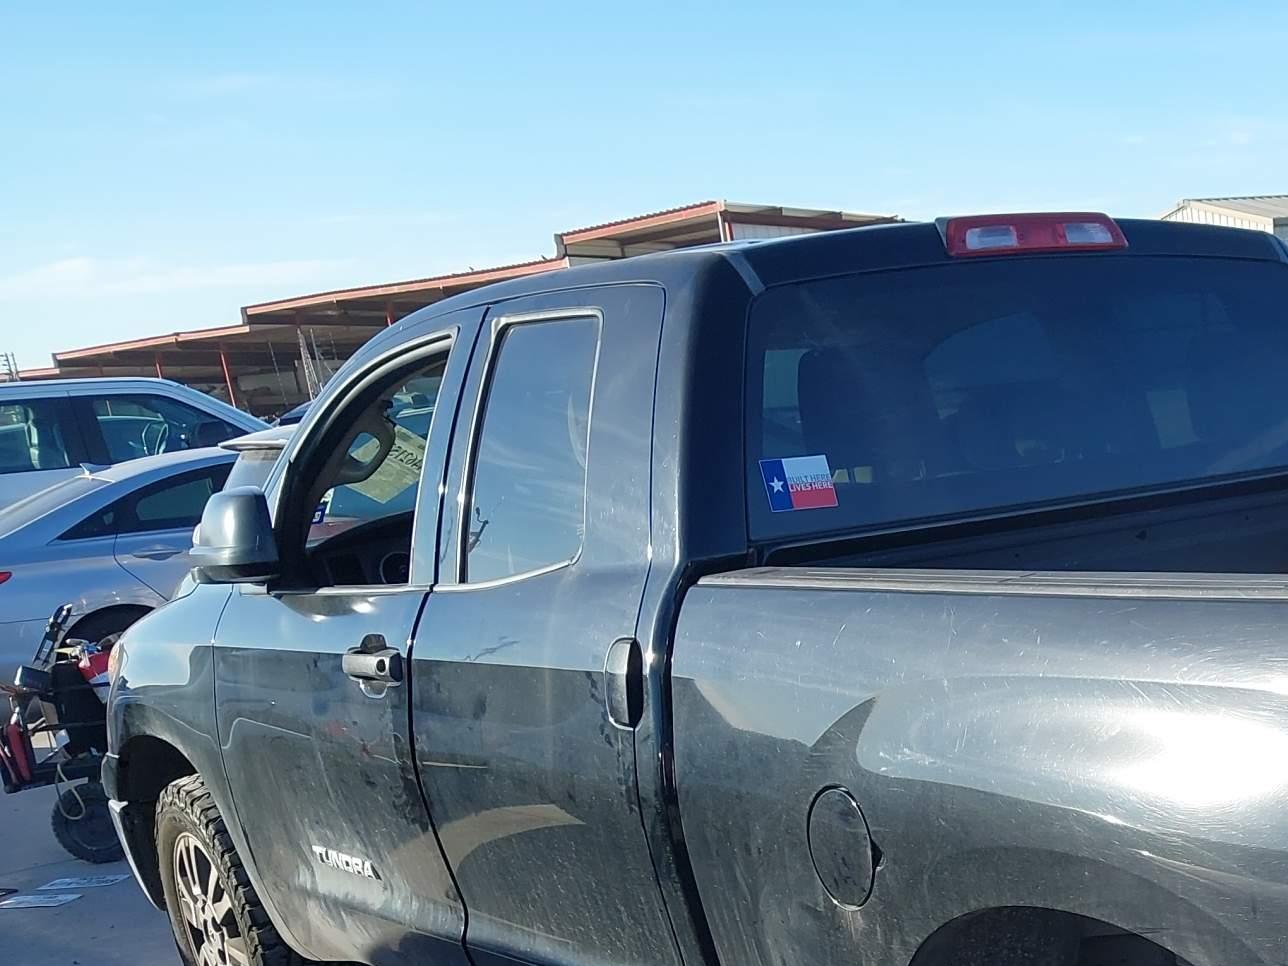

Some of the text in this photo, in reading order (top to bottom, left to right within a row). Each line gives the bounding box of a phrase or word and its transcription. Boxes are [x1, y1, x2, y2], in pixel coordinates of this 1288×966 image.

[789, 481, 833, 492] LIVES HERE
[311, 845, 379, 880] TUNDRA
